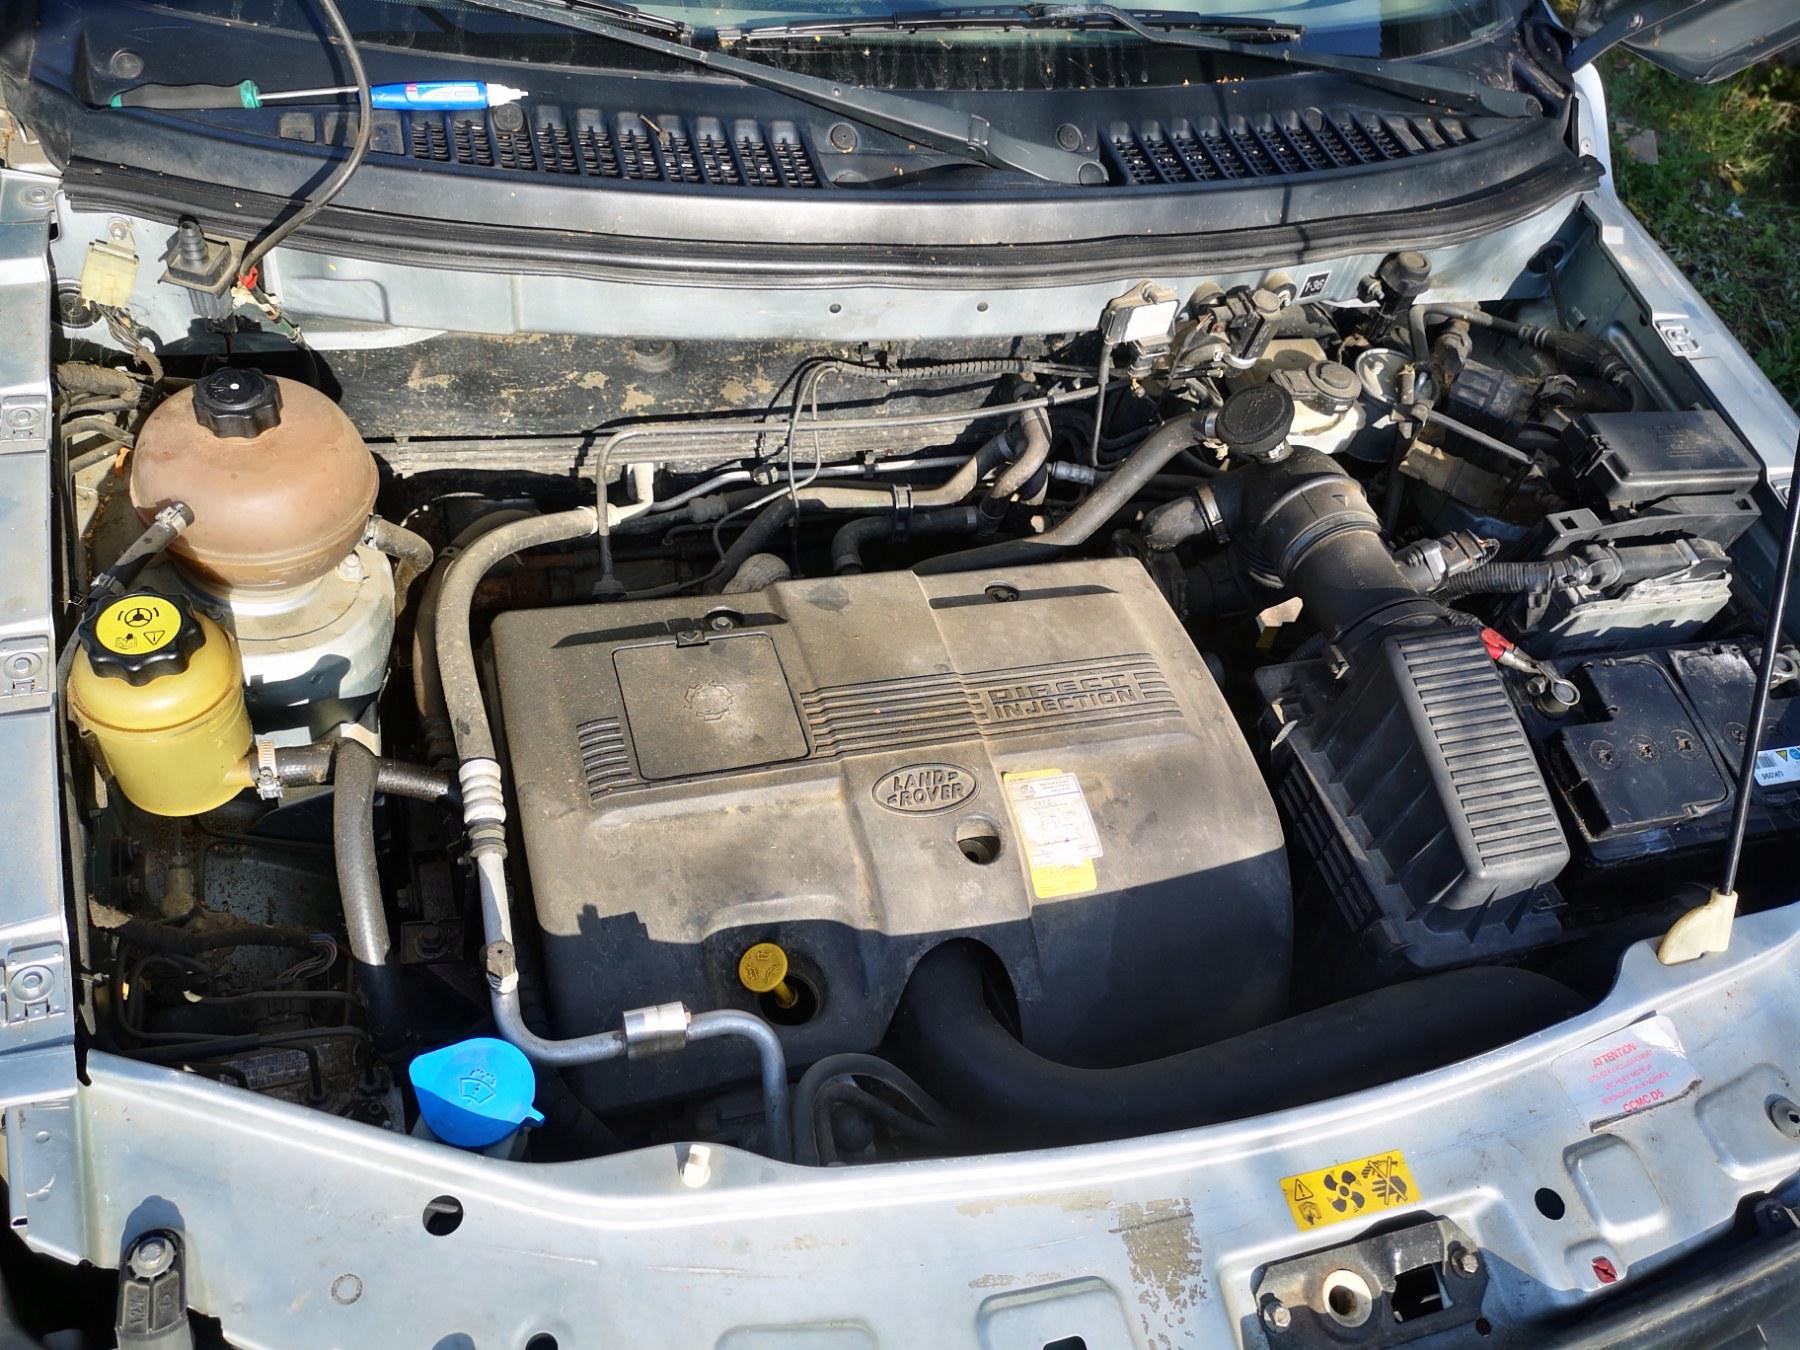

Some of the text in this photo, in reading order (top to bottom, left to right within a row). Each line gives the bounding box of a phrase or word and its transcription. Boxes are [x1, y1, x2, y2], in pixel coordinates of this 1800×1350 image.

[988, 674, 1128, 702] DIRECT
[994, 688, 1138, 720] INJECTION
[893, 769, 946, 793] LAND
[899, 783, 965, 807] ROVER
[1592, 1042, 1638, 1068] ATTENTION
[1623, 1095, 1652, 1113] CCMC
[1651, 1088, 1664, 1101] D5
